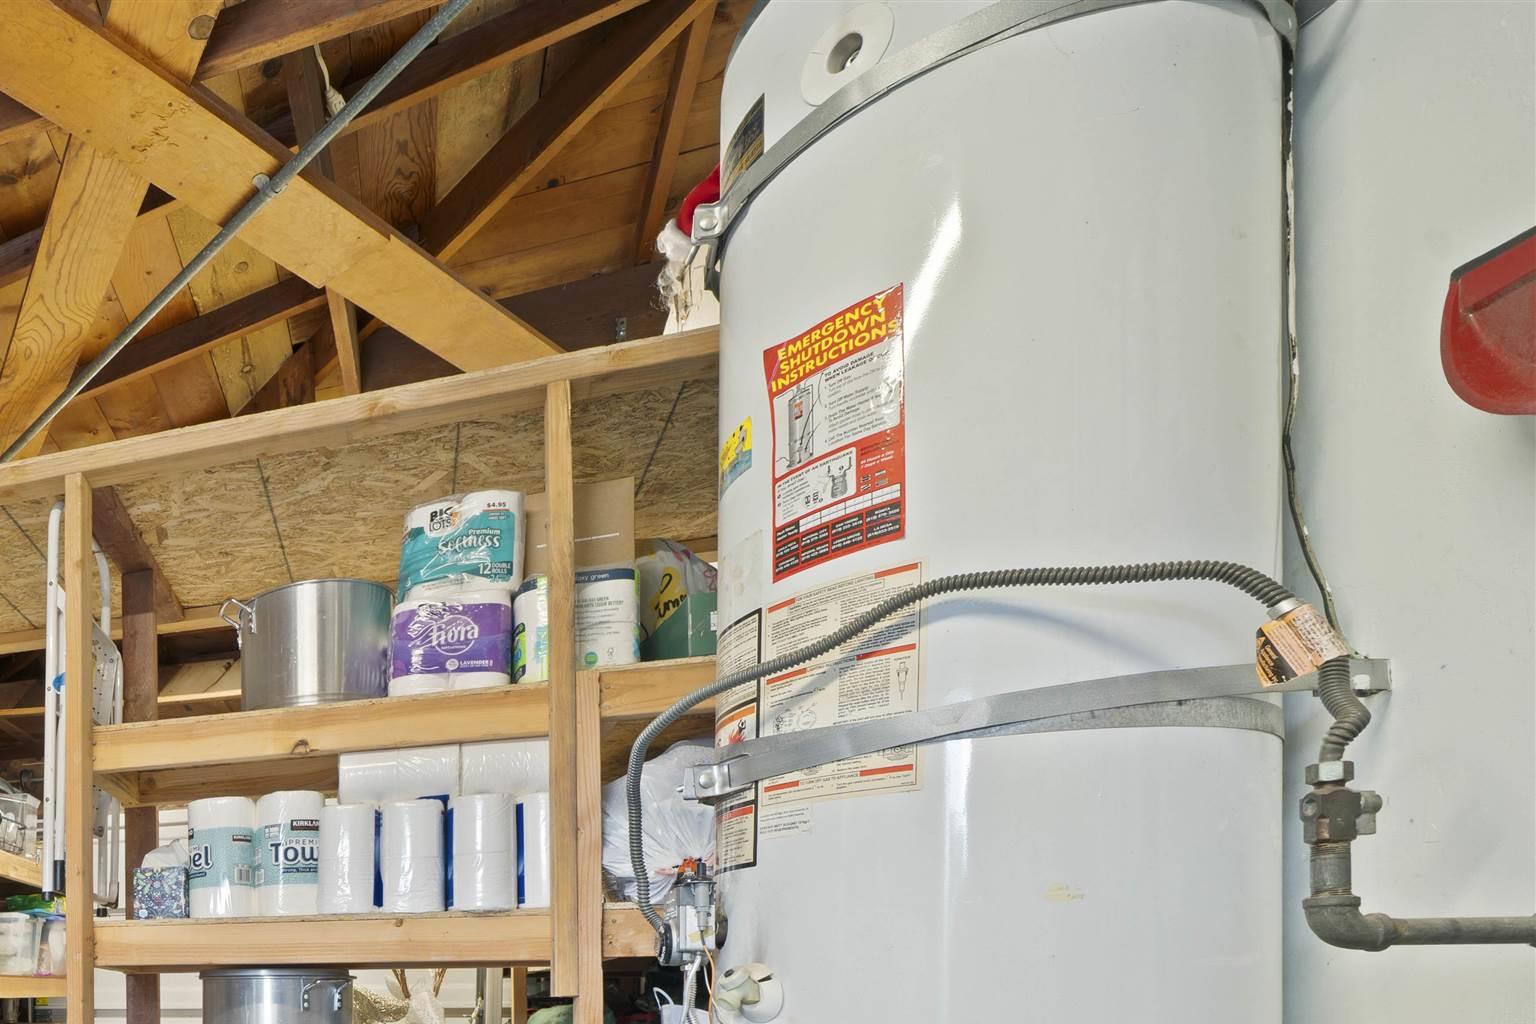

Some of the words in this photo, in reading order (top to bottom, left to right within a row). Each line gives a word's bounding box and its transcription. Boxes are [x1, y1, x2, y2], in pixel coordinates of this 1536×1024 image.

[777, 296, 885, 360] EMERGENCY
[780, 311, 885, 374] SHUTDOWN
[771, 320, 898, 393] INSTRUCTIONS
[429, 506, 454, 522] BIG
[438, 535, 501, 555] Softness
[478, 563, 492, 574] 12
[189, 846, 211, 867] el
